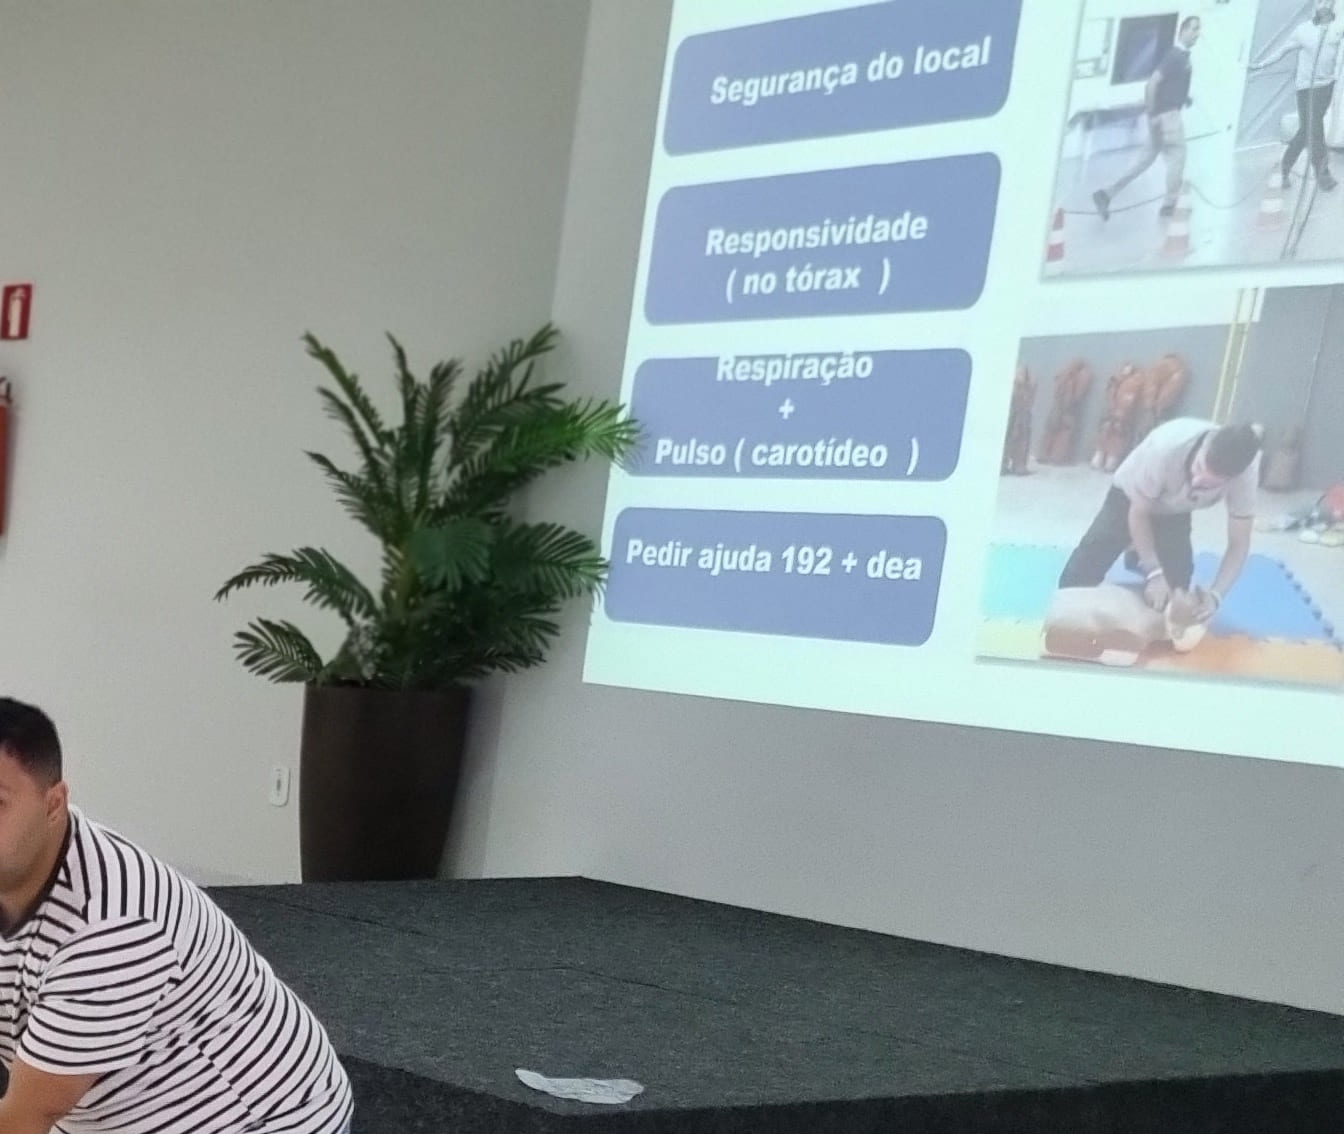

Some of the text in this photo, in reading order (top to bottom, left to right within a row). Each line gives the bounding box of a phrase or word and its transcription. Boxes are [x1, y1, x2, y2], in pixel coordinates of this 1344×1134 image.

[710, 35, 992, 106] Segurança do local
[705, 211, 929, 257] Responsividade
[725, 257, 891, 303] ( no tórax )
[716, 351, 874, 386] Respiração
[778, 398, 795, 419] +
[654, 437, 920, 475] Pulso ( carotídeo )
[626, 539, 923, 580] Pedir ajuda 192 + dea
